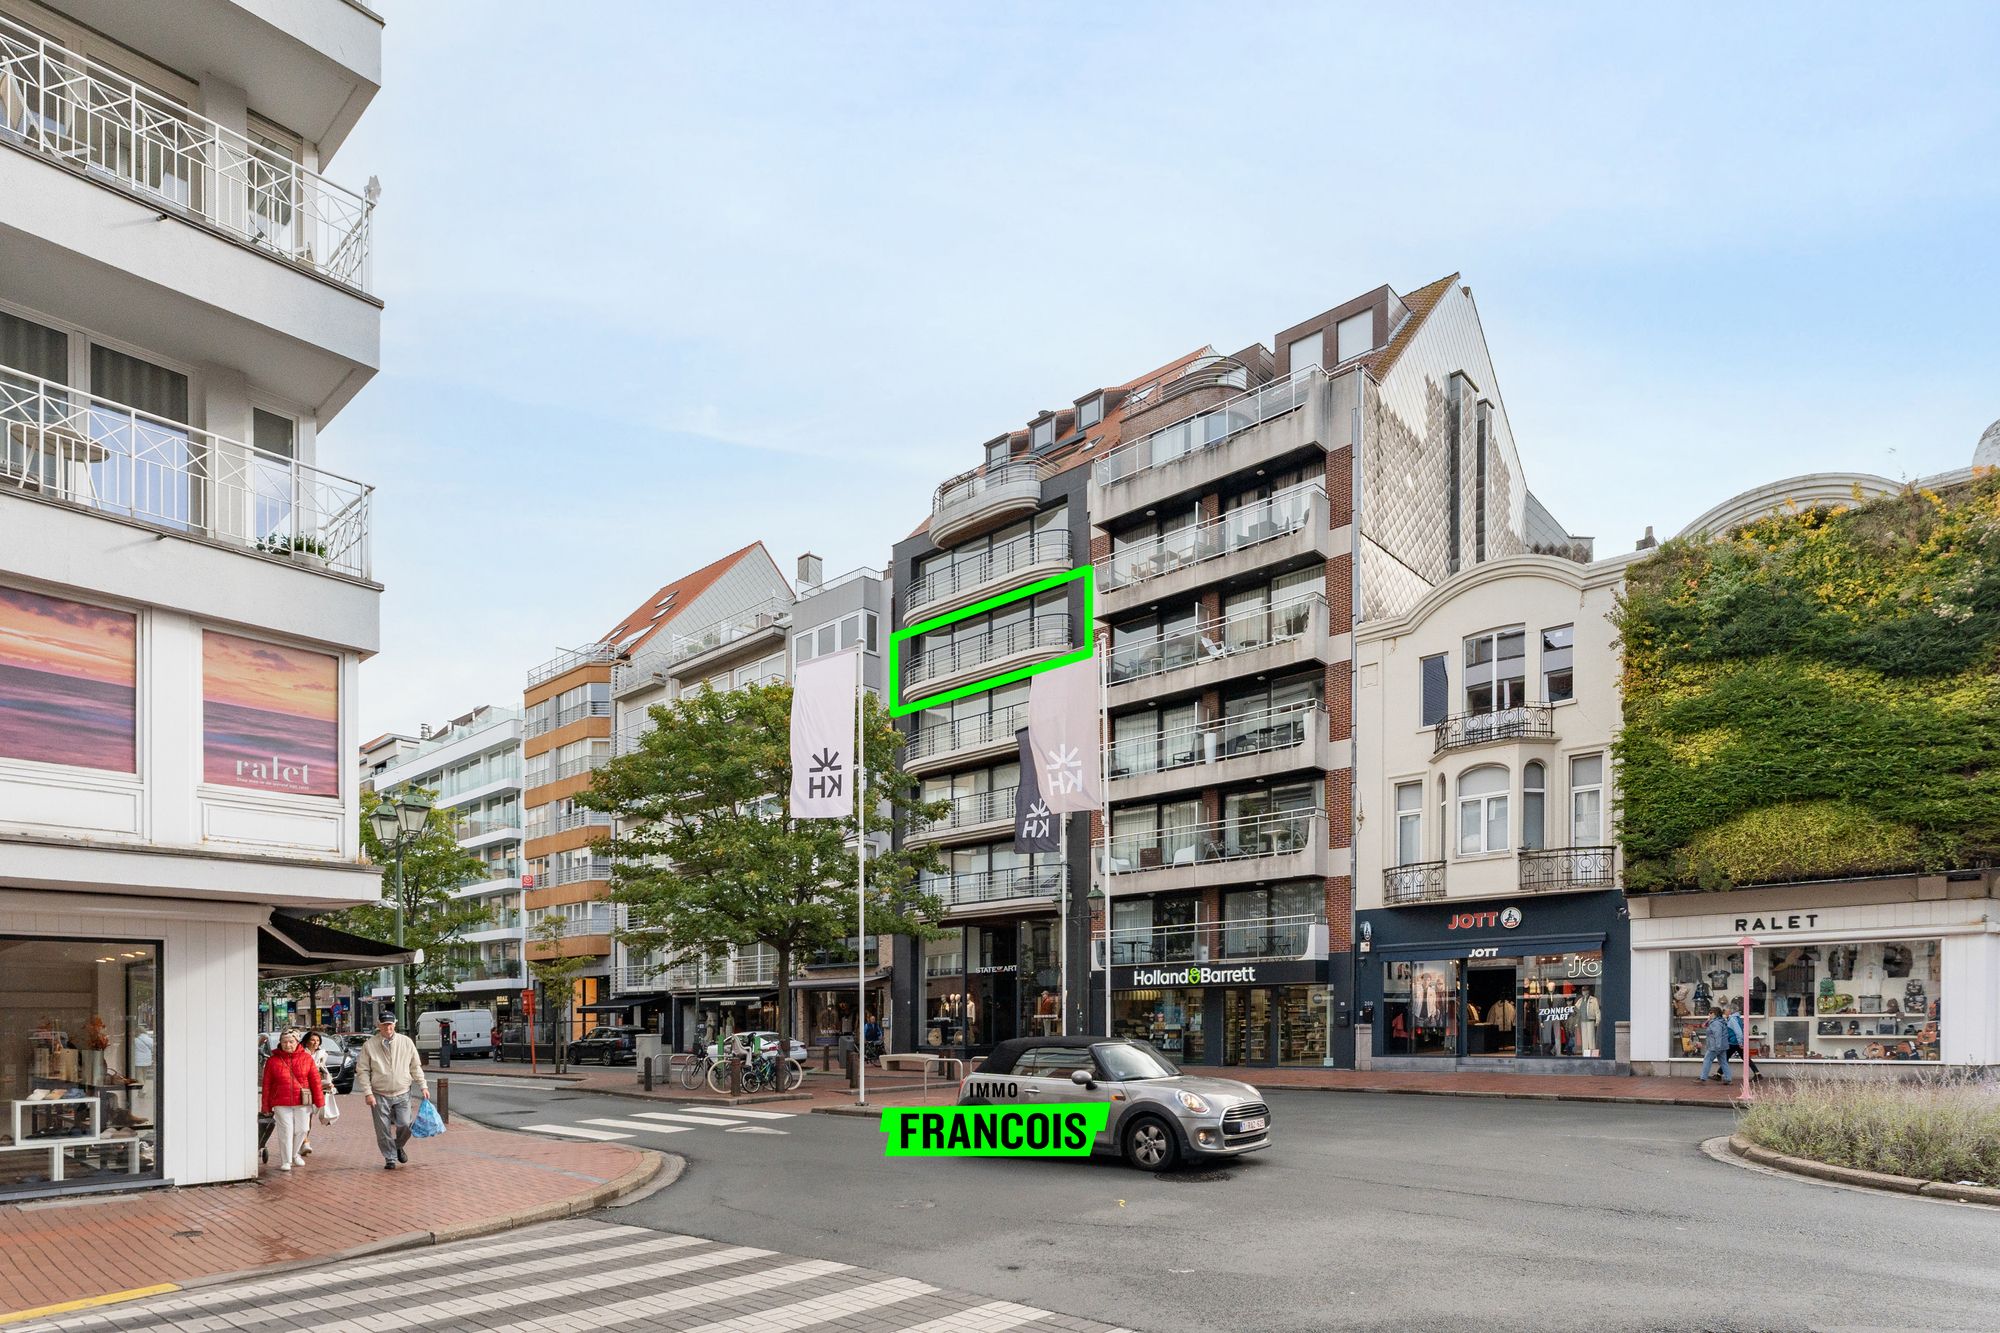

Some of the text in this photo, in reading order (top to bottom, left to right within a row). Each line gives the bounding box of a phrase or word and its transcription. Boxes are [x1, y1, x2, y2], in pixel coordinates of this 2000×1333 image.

[236, 755, 309, 785] ralet
[1448, 911, 1498, 930] JOTT
[1735, 914, 1818, 932] RALET
[1468, 947, 1499, 958] JOTT
[1003, 964, 1017, 972] ART
[1545, 1014, 1569, 1022] START
